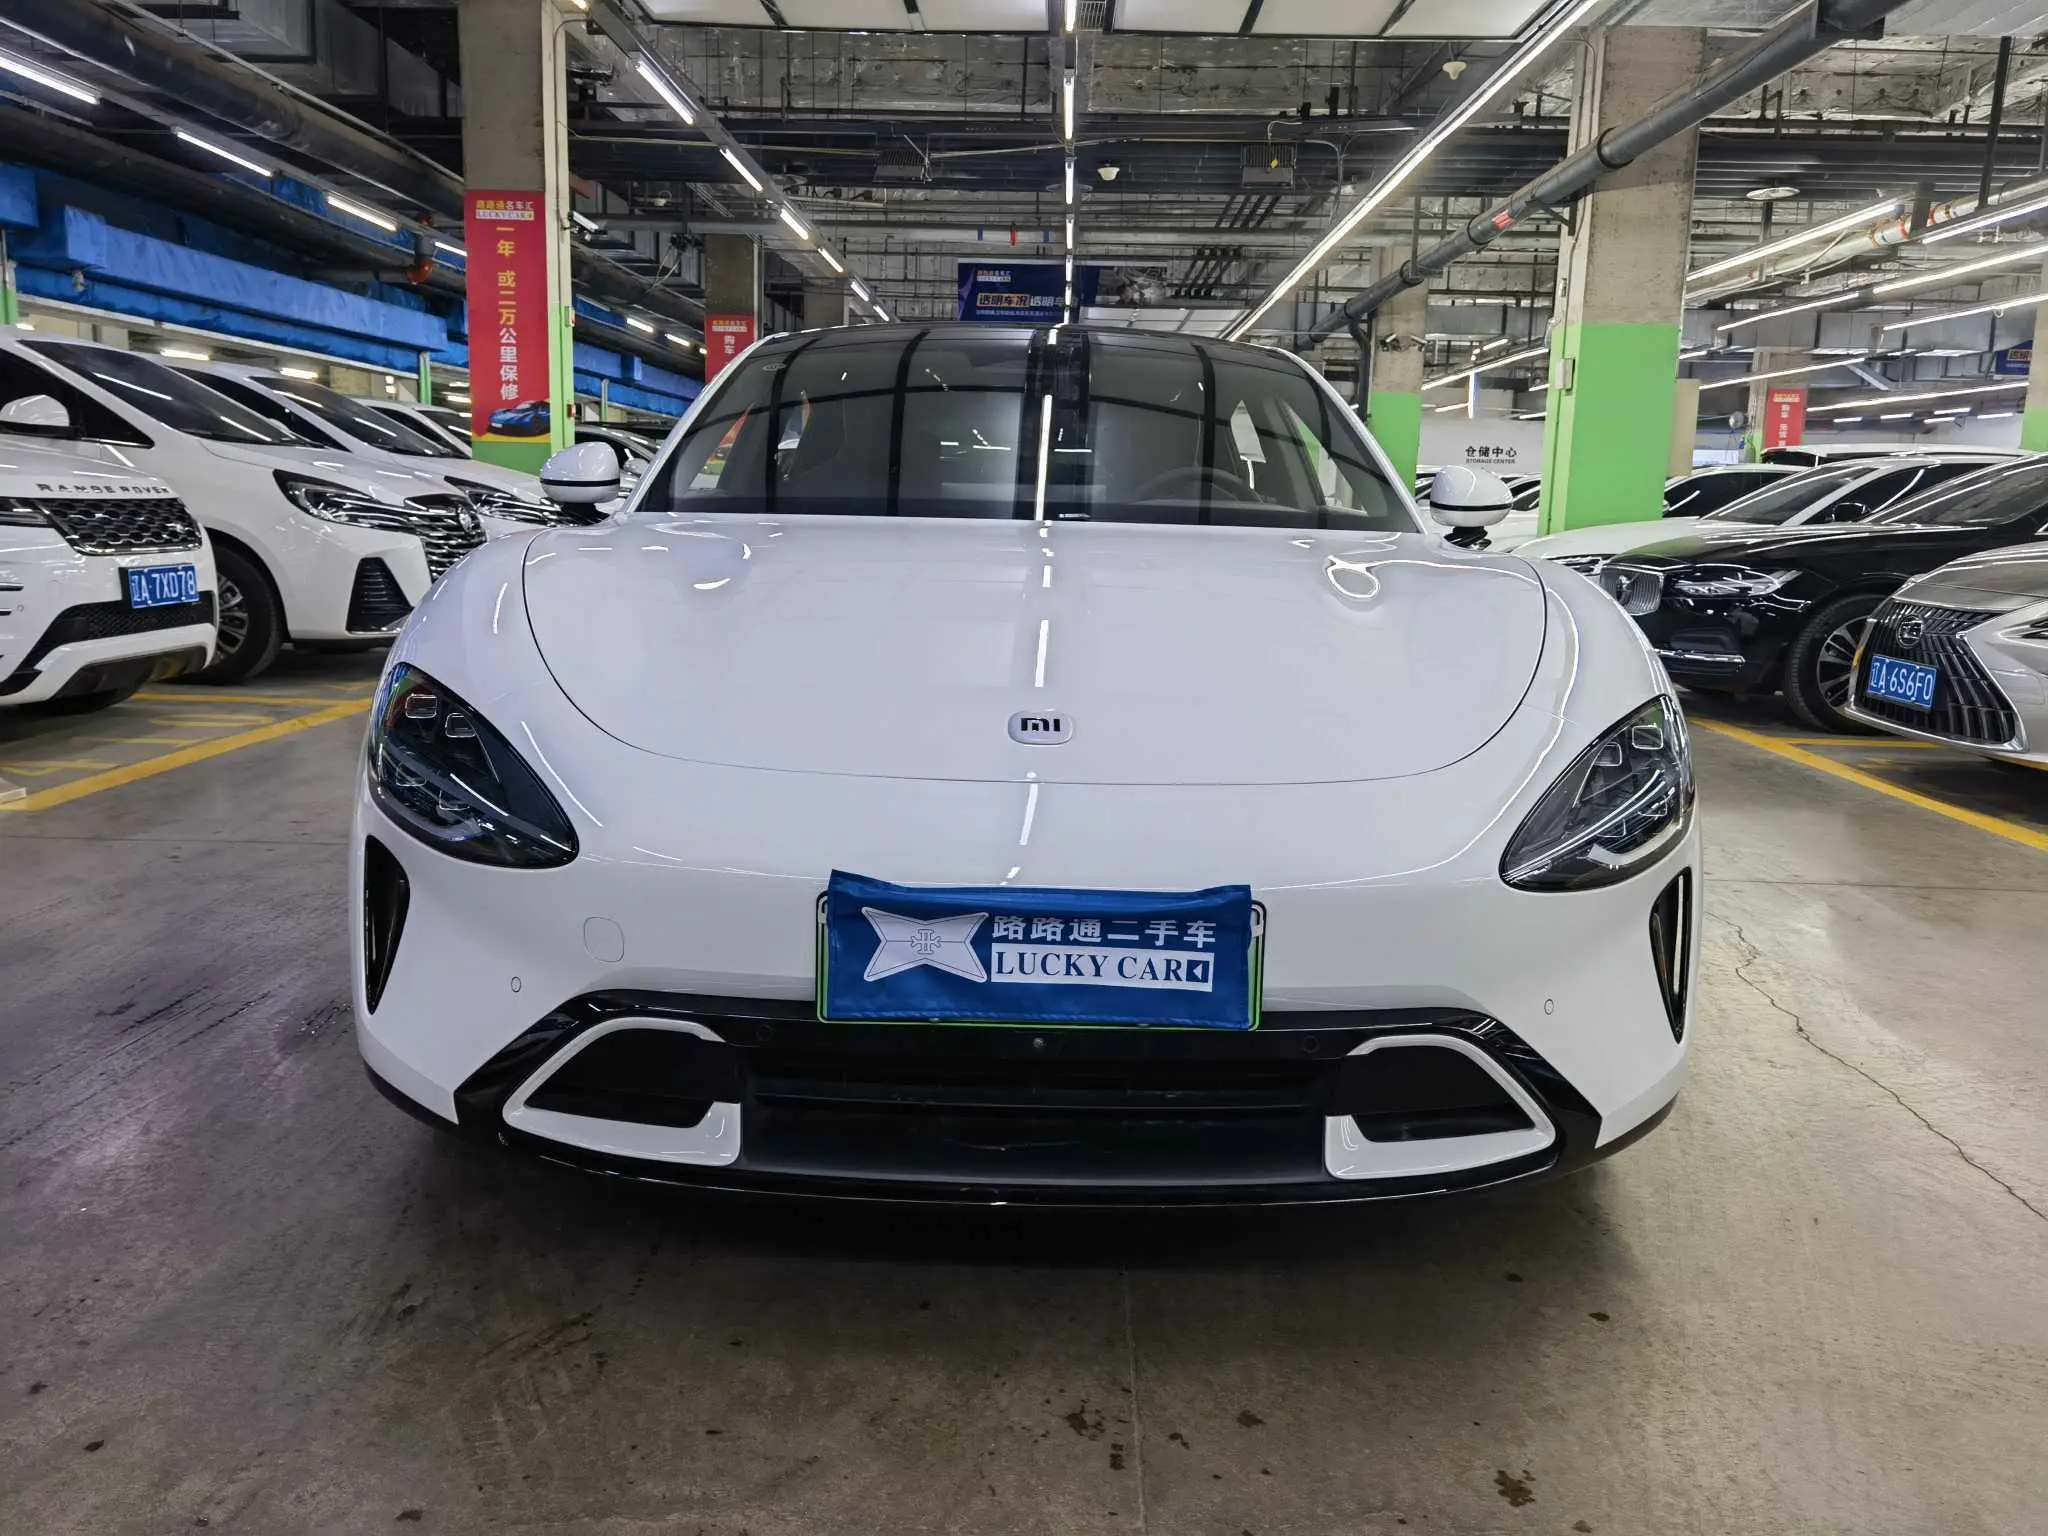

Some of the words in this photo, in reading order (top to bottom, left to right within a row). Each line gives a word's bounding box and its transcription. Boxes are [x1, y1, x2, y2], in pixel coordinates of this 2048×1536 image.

[1465, 446, 1518, 458] 仓储中心
[36, 483, 116, 494] RANGE
[992, 915, 1217, 949] 路路通二手车
[995, 951, 1110, 978] LUCKY
[1116, 956, 1184, 982] CAR
